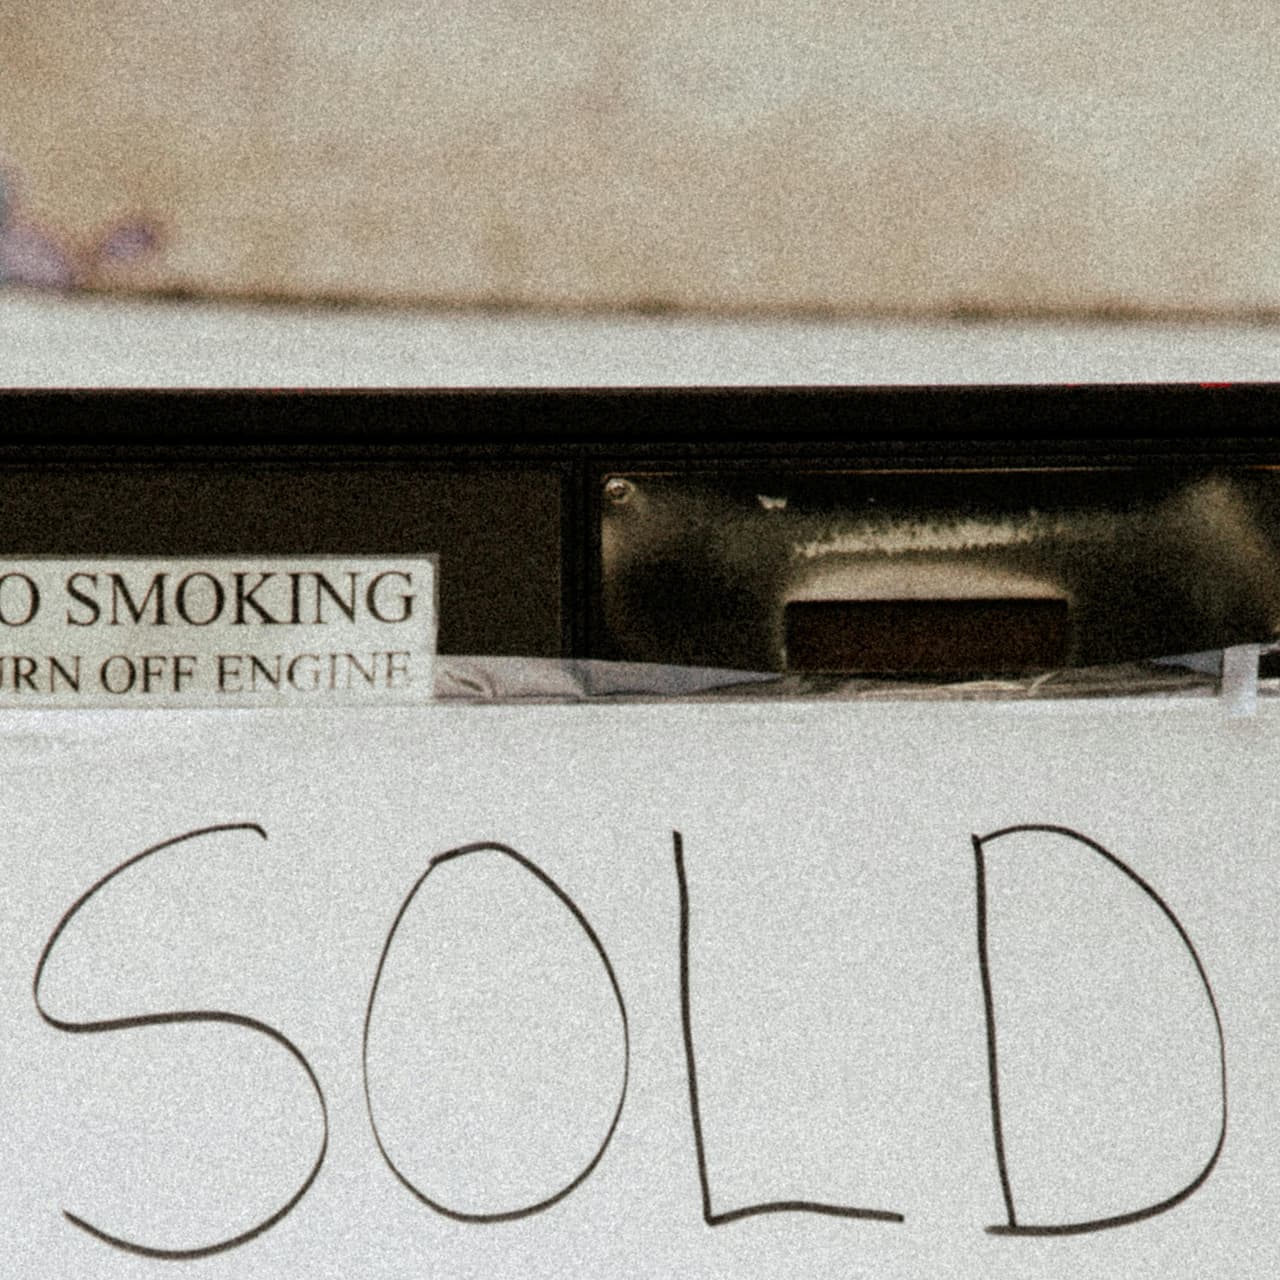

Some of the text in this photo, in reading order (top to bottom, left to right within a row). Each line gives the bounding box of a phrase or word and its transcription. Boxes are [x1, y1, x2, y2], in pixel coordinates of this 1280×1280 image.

[66, 572, 414, 627] SMOKING
[99, 655, 198, 693] OFF
[216, 651, 411, 692] ENGINE
[34, 823, 1226, 1260] SOLD
